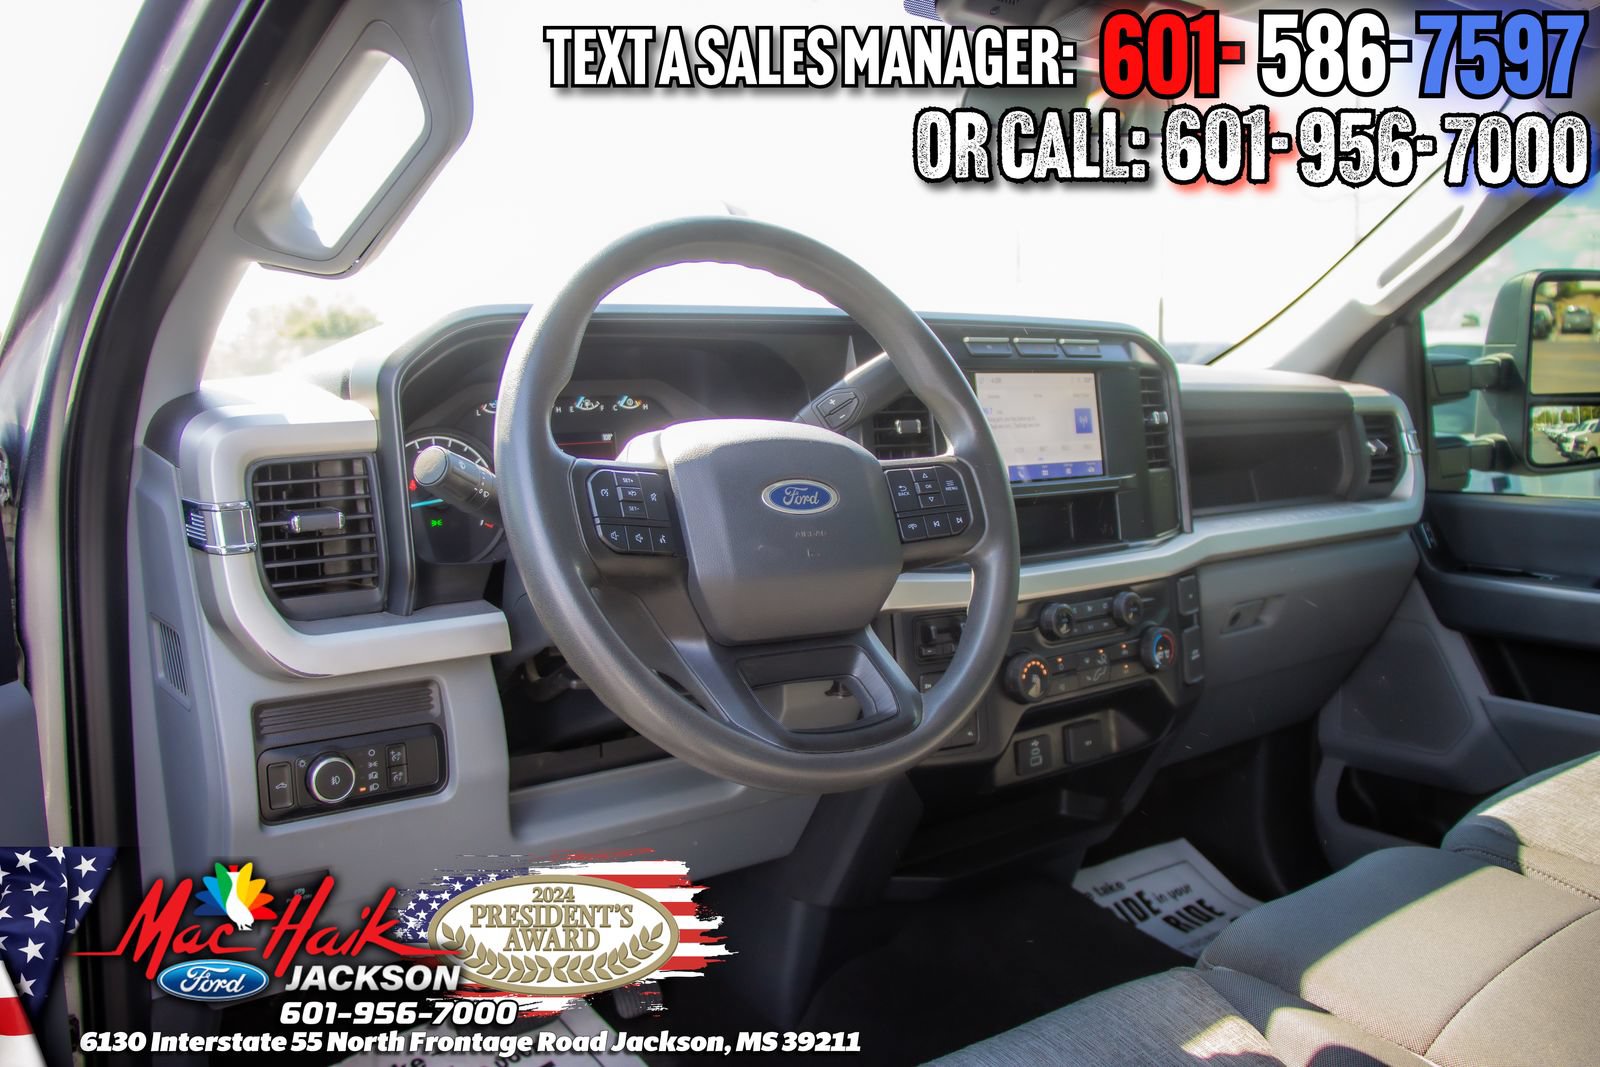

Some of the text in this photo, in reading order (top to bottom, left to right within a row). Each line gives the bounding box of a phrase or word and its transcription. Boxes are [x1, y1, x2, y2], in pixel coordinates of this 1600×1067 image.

[782, 485, 820, 506] Ford
[1113, 890, 1162, 924] IDE
[1162, 899, 1225, 933] RIDE
